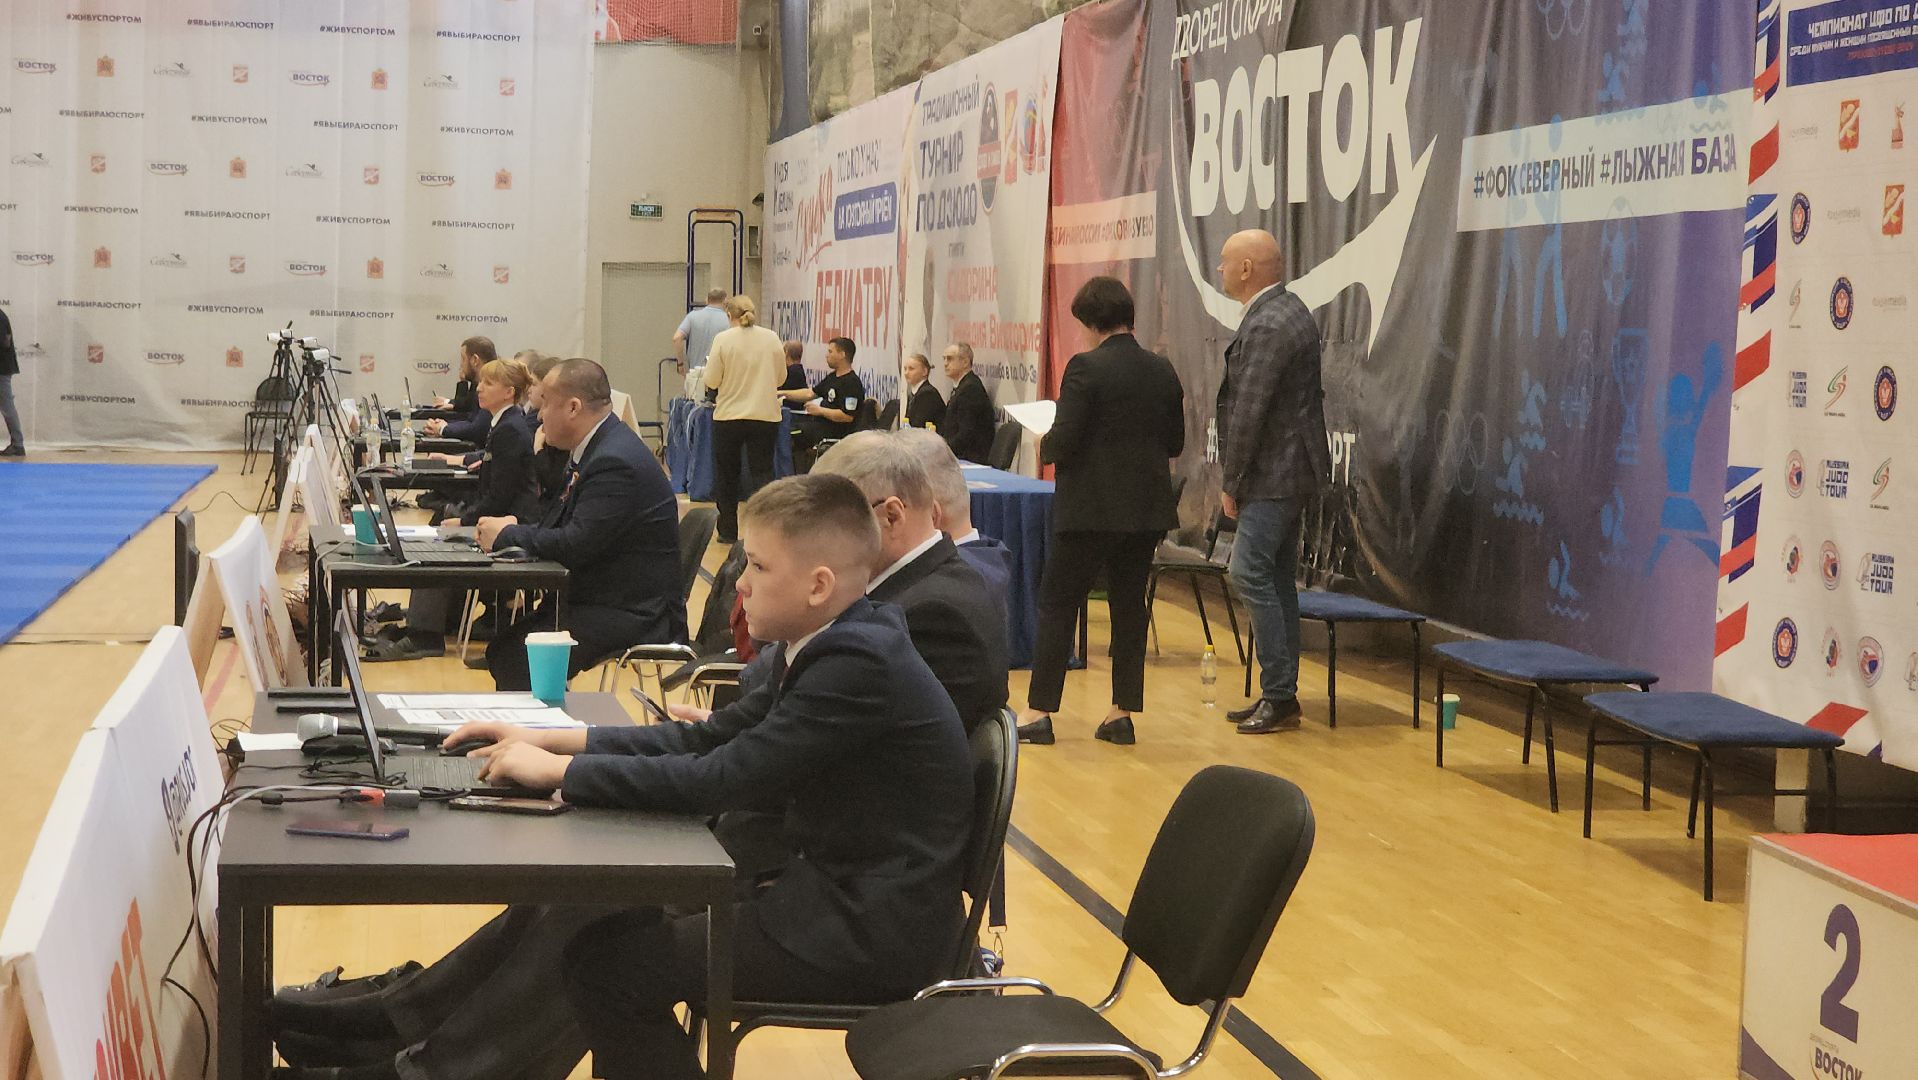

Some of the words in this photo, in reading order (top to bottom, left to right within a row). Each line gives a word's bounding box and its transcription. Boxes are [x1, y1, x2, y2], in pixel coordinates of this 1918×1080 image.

[66, 13, 142, 24] #ЖИВУСПОРТОМ
[187, 18, 275, 30] #ЯВЫБИРАЮСПОРТ
[1808, 12, 1868, 38] ЧЕМПИОНАТ
[1869, 7, 1893, 29] ЦФО
[1895, 4, 1910, 23] ПО
[319, 24, 396, 36] #ЖИВУСПОРТОМ
[436, 30, 521, 42] #ЯВЫБИРАЮСПОРТ
[1789, 45, 1812, 57] СРЕДИ
[18, 60, 56, 70] ВОСТОК
[293, 73, 330, 83] ВОСТОК
[922, 74, 980, 127] ТРАДИЦИОННЫЙ
[58, 109, 145, 119] #ЯВЫБИРАЮСПОРТ
[191, 114, 268, 125] #ЖИВУСПОРТОМ
[1189, 17, 1423, 216] ВОСТОК
[313, 120, 399, 131] #ЯВЫБИРАЮСПОРТ
[440, 125, 514, 137] #ЖИВУСПОРТОМ
[920, 130, 963, 180] ТУРНИР
[1600, 140, 1685, 185] #ЛЫЖНАЯ
[1691, 133, 1737, 176] БАЗА
[151, 162, 187, 171] ВОСТОК
[420, 174, 455, 183] ВОСТОК
[64, 205, 139, 214] #ЖИВУСПОРТОМ
[915, 190, 935, 232] ПО
[937, 182, 978, 230] ДЗЮДО
[184, 209, 271, 220] #ЯВЫБИРАЮСПОРТ
[315, 215, 391, 226] #ЖИВУСПОРТОМ
[431, 220, 516, 231] #ЯВЫБИРАЮСПОРТ
[16, 253, 54, 262] ВОСТОК
[289, 263, 326, 272] ВОСТОК
[56, 299, 142, 310] #ЯВЫБИРАЮСПОРТ
[187, 304, 264, 315] #ЖИВУСПОРТОМ
[814, 266, 892, 350] ПЕДИАТРУ
[309, 309, 394, 319] #ЯВЫБИРАЮСПОРТ
[436, 314, 508, 324] #ЖИВУСПОРТОМ
[147, 352, 185, 361] ВОСТОК
[417, 361, 450, 371] ВОСТОК
[60, 393, 136, 404] #ЖИВУСПОРТОМ
[1825, 470, 1849, 484] JUDO
[1825, 484, 1848, 499] TOUR
[1870, 564, 1894, 579] JUDO
[1870, 579, 1893, 594] TOUR
[1820, 903, 1861, 1044] 2
[1815, 1047, 1864, 1080] ВОСТОК
